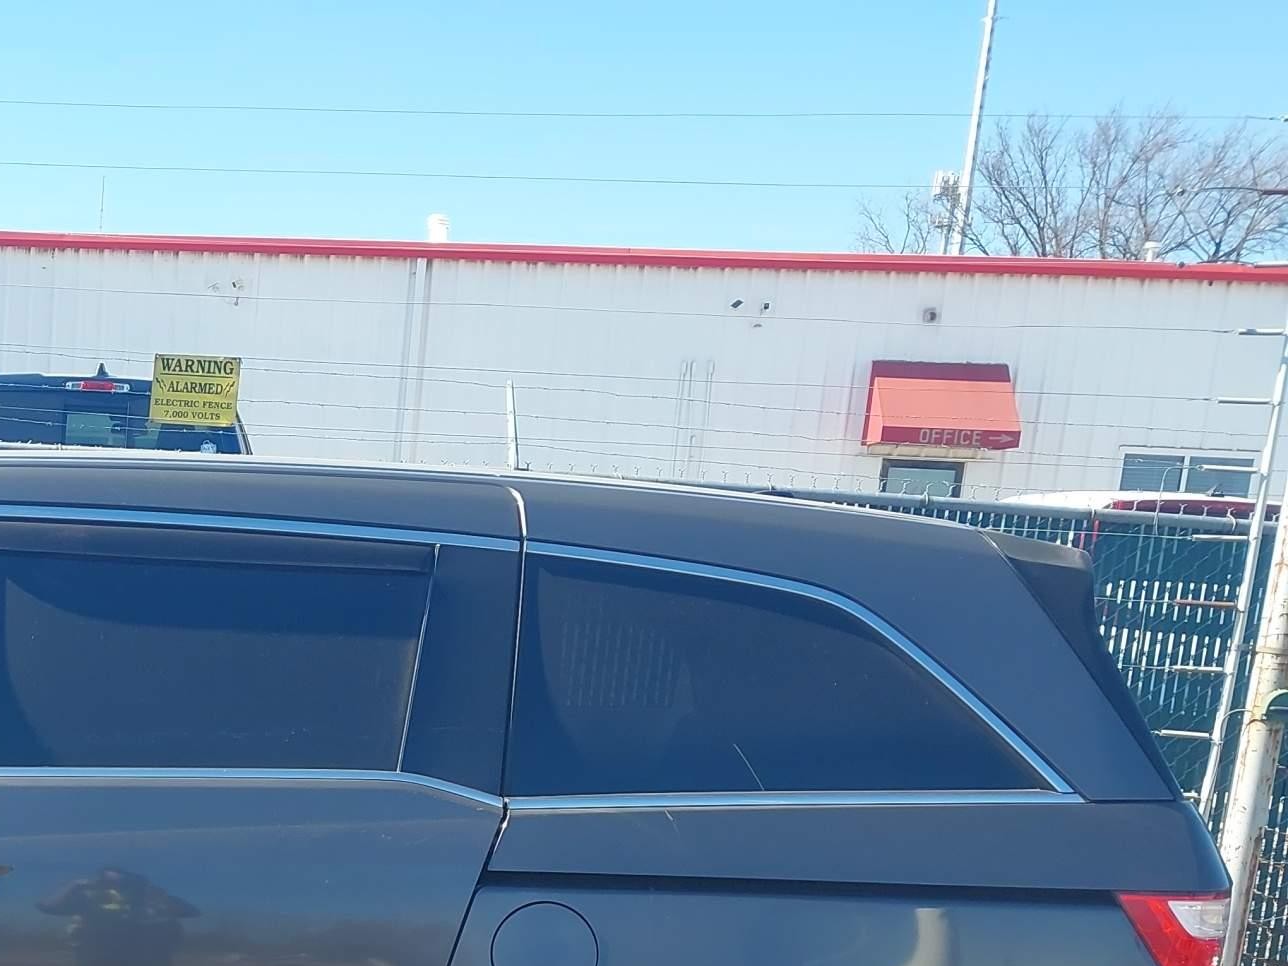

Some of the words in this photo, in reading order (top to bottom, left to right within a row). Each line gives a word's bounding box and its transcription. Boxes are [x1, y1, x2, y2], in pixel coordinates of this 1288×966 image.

[160, 357, 234, 375] WARNING
[167, 381, 223, 395] ALARMED
[153, 398, 200, 408] ELECTRIC
[202, 401, 233, 410] FENCE
[191, 412, 221, 421] VOLTS
[919, 428, 983, 446] OFFICE
